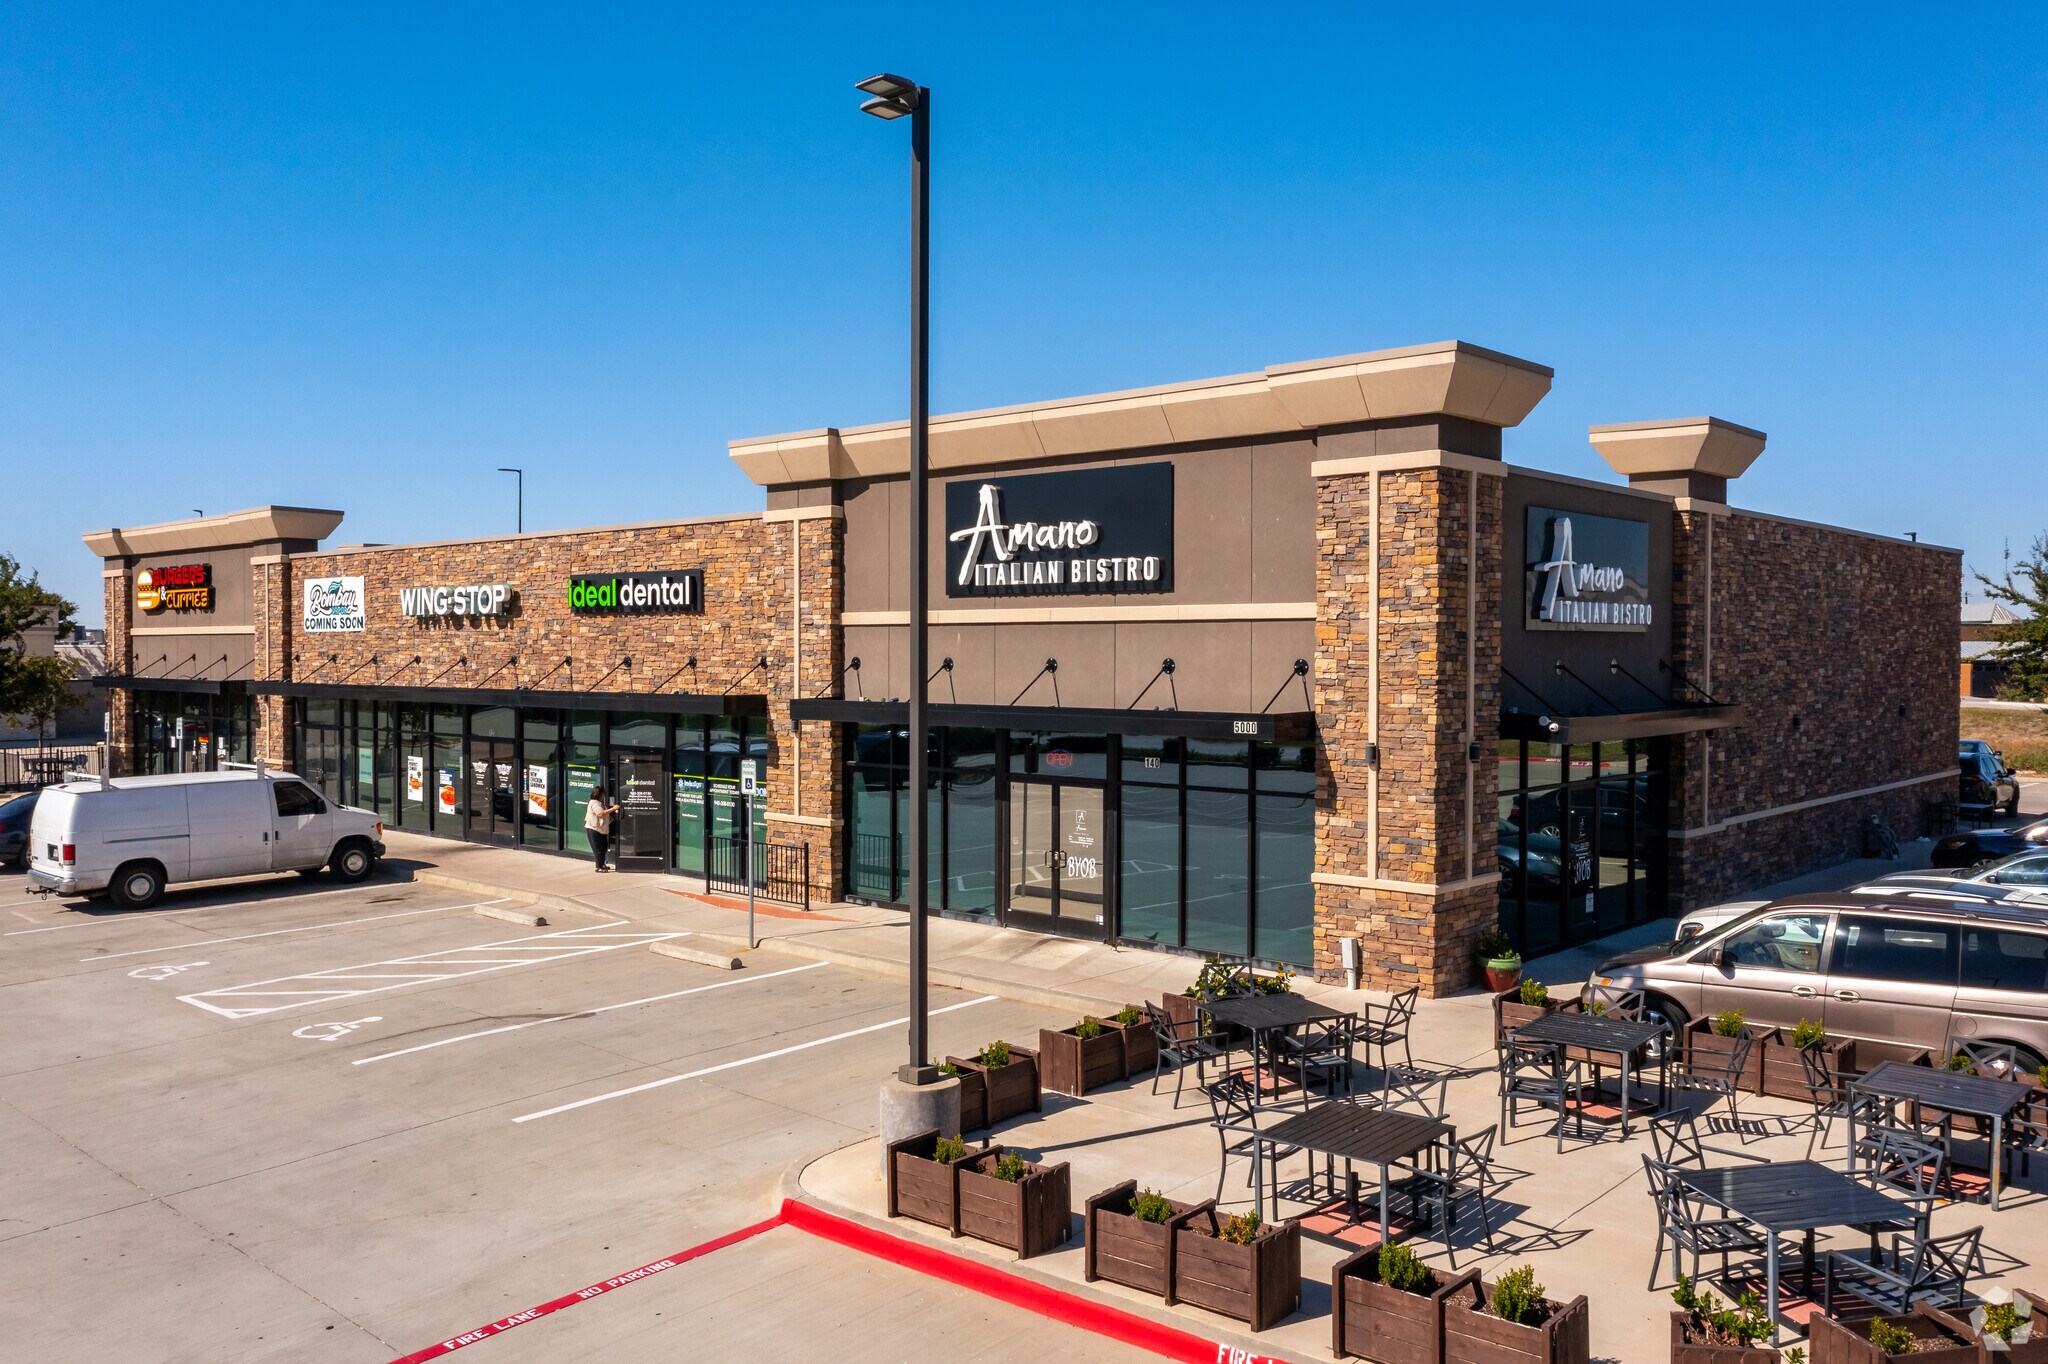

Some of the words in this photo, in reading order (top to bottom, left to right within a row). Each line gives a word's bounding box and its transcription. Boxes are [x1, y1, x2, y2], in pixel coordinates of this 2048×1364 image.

[950, 484, 1098, 585] Amano
[153, 565, 204, 586] BURGERS
[975, 561, 1064, 586] ITALIAN
[1071, 556, 1160, 582] BISTRO
[1534, 517, 1624, 620] Amano
[568, 578, 616, 608] ideal
[620, 575, 690, 606] dental
[305, 617, 337, 629] COMING
[340, 617, 363, 629] SOON
[1559, 600, 1608, 623] ITALIAN
[1613, 603, 1652, 625] BISTRO
[1234, 722, 1257, 734] 5000
[1046, 752, 1073, 766] OPEN
[1145, 758, 1160, 768] 140
[1067, 856, 1096, 879] BYOB
[443, 1329, 488, 1350] FIRE
[493, 1308, 543, 1332] LANE
[577, 1286, 603, 1299] NO
[607, 1259, 676, 1288] PARKING
[1217, 1343, 1258, 1364] FIRE
